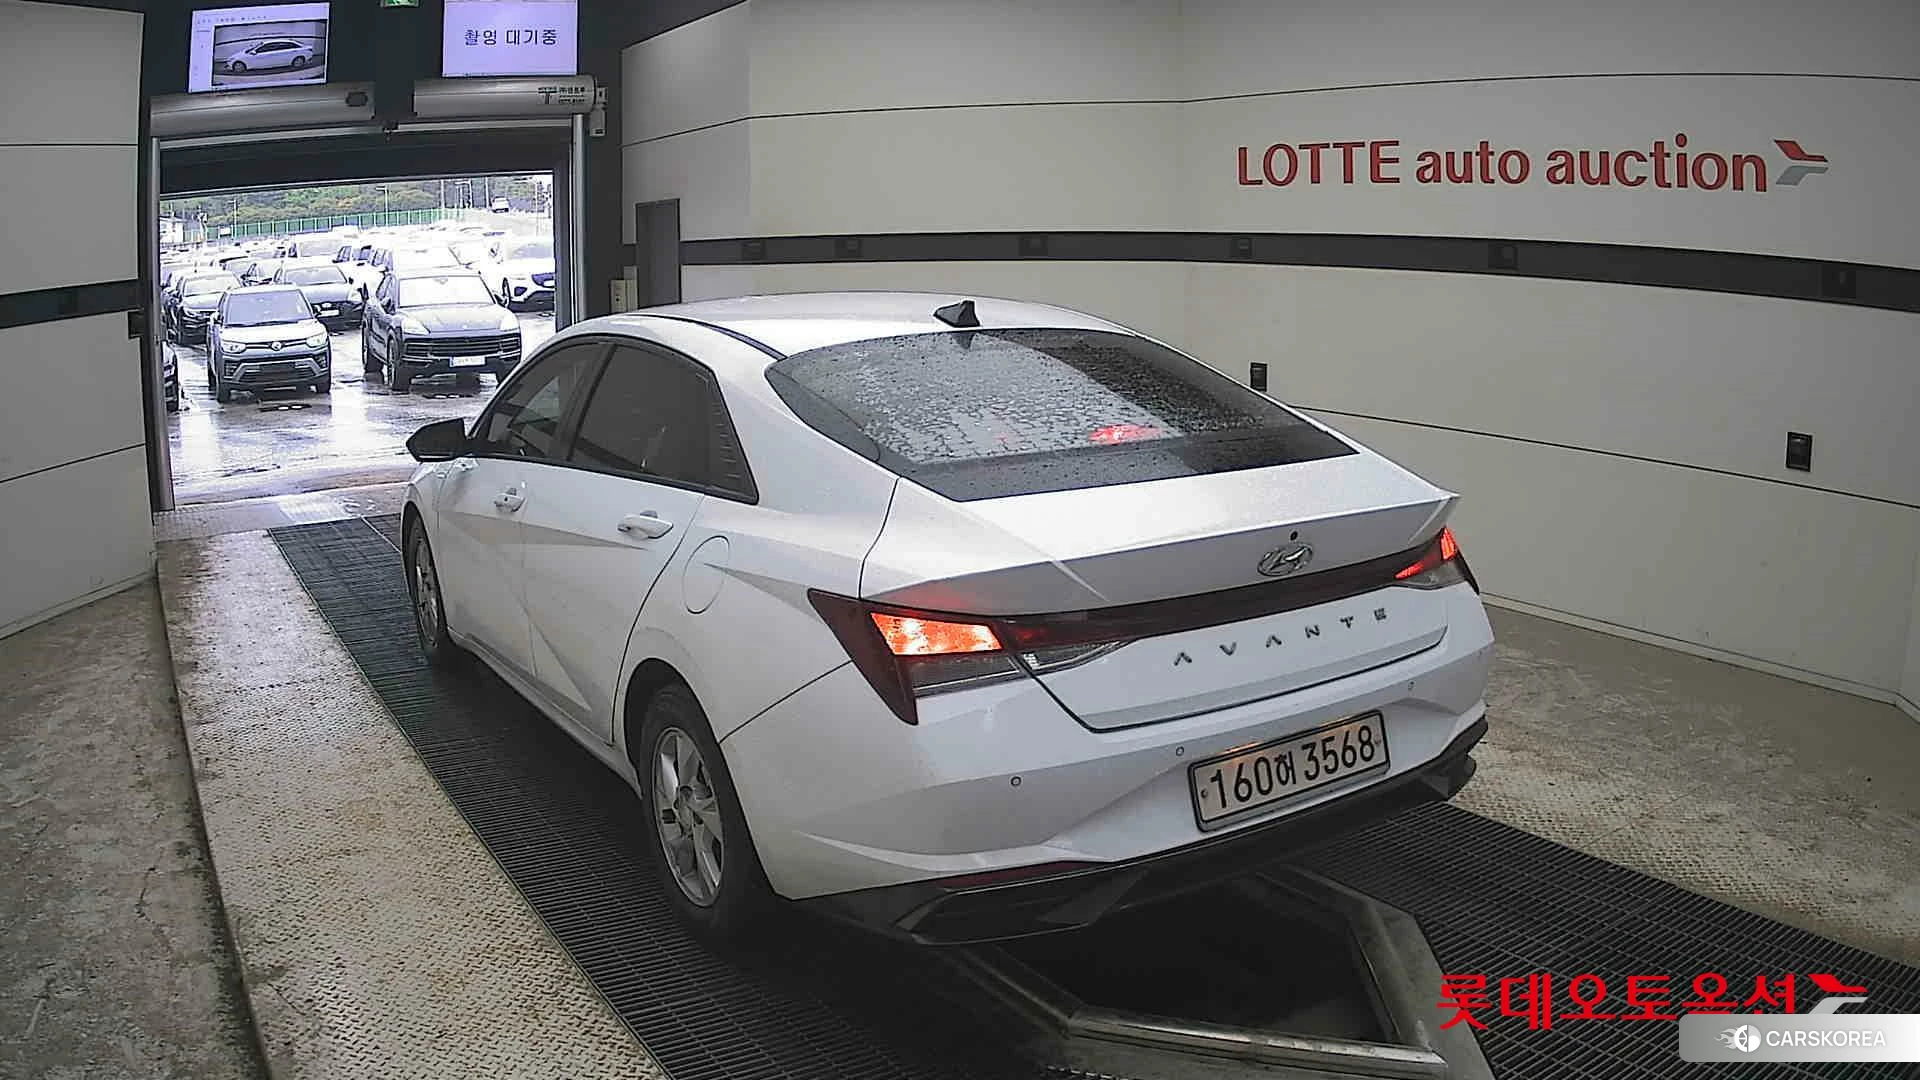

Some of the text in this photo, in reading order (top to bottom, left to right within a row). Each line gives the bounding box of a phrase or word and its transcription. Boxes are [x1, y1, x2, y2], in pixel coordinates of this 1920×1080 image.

[505, 29, 558, 46] 대기중
[1238, 132, 1768, 193] LOTTE auto auction
[1173, 607, 1388, 667] AVANTE
